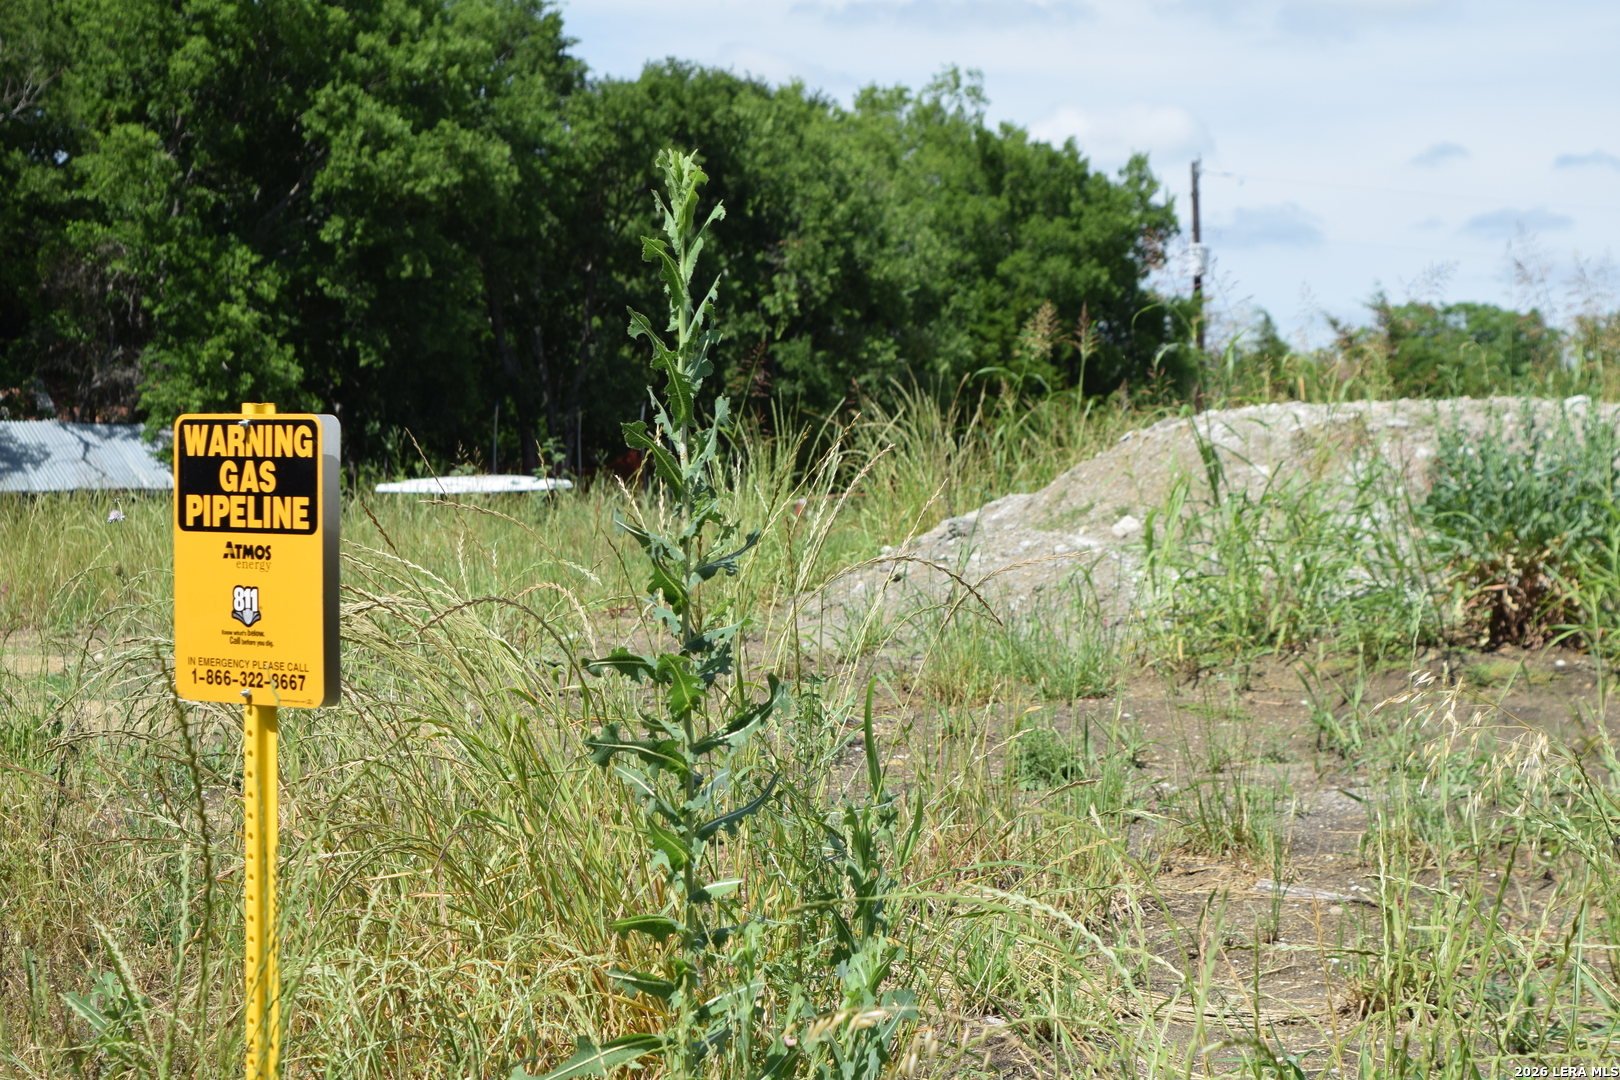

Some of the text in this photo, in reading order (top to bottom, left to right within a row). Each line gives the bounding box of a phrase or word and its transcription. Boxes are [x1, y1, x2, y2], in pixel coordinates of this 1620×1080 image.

[183, 424, 313, 458] WARNING
[219, 460, 277, 493] GAS
[185, 494, 310, 530] PIPELINE
[236, 560, 272, 573] energy
[233, 586, 259, 612] 811
[229, 636, 241, 645] Call
[188, 656, 309, 673] IN EMERGENCY PLEASE CALL
